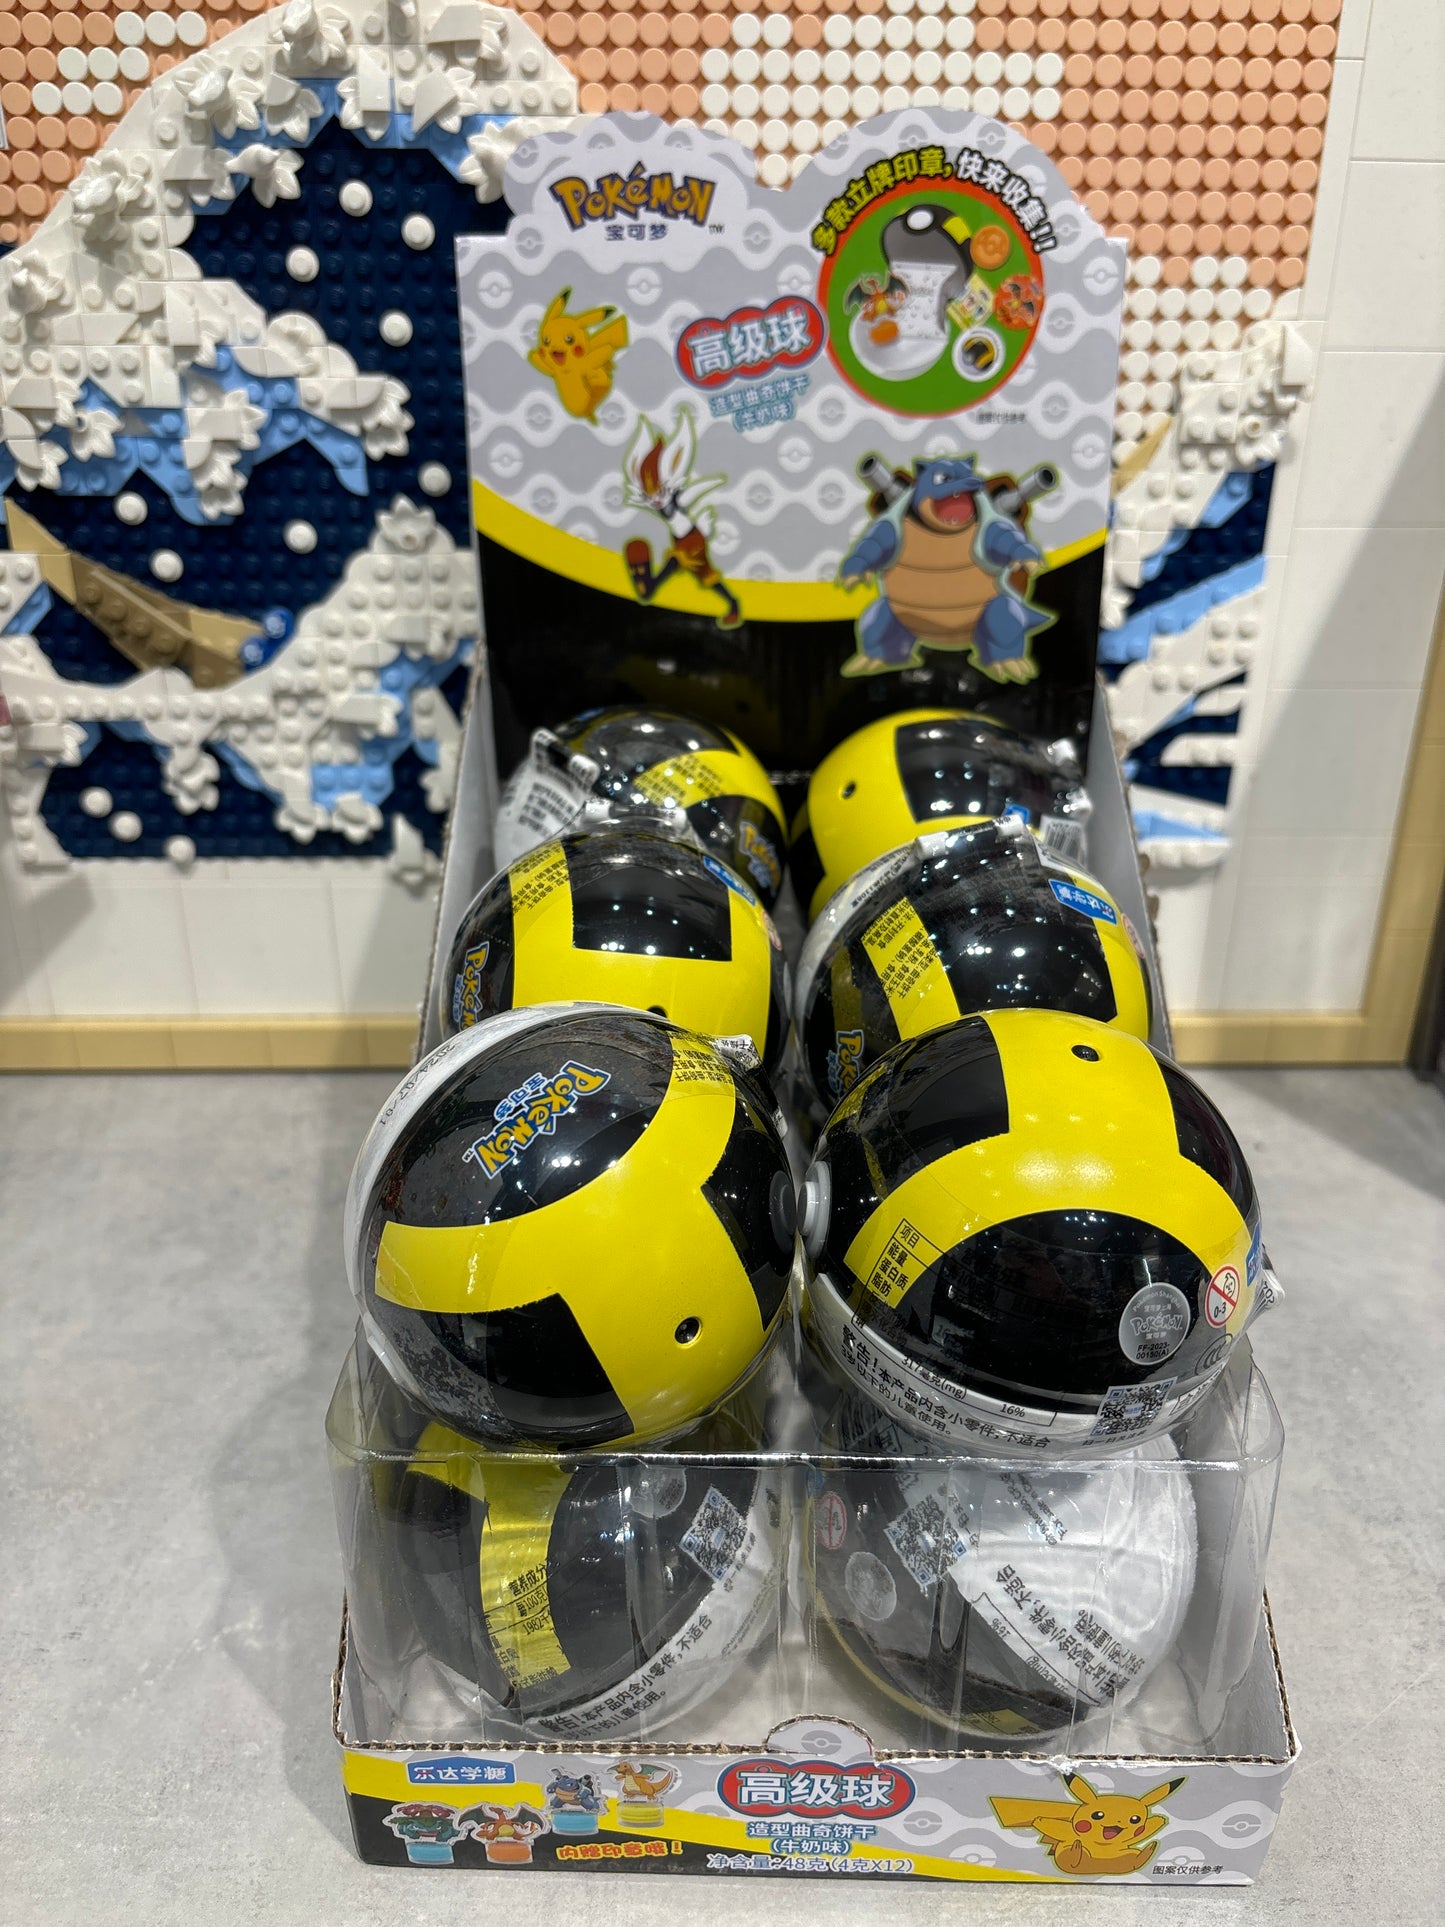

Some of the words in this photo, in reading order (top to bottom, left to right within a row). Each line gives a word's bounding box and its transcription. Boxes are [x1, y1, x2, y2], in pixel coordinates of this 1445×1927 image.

[605, 224, 668, 241] 宝可梦
[686, 304, 814, 378] 高级球
[494, 1072, 547, 1122] 宝可梦
[900, 1224, 921, 1249] 项目
[886, 1241, 909, 1268] 能量
[878, 1256, 909, 1291] 蛋白质
[870, 1271, 893, 1298] 脂肪
[1213, 1301, 1228, 1319] 0-3
[998, 1402, 1026, 1419] 16%
[413, 1765, 508, 1781] 乐达学糖
[738, 1767, 893, 1808] 高级球
[748, 1822, 877, 1840] 造型曲奇饼干
[771, 1839, 852, 1855] (牛奶味)
[1152, 1865, 1224, 1875] 图案仅供参考
